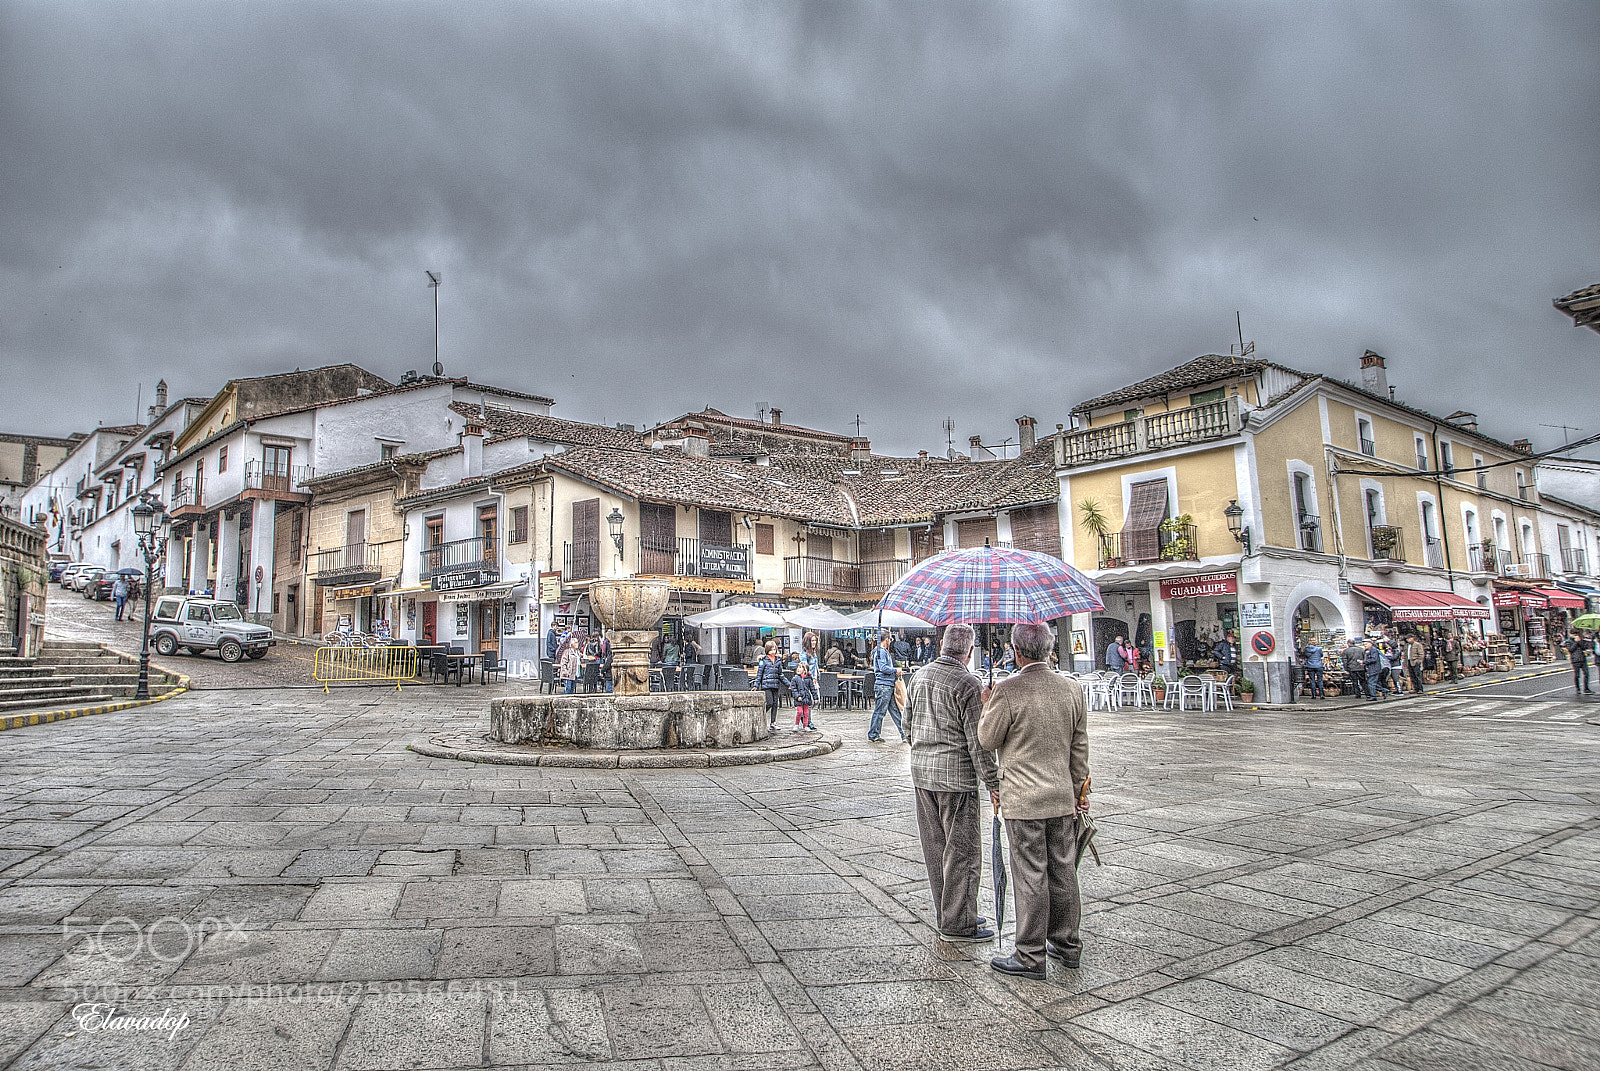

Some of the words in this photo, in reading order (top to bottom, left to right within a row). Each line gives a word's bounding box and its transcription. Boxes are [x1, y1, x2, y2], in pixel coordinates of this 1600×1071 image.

[1161, 577, 1195, 586] ARTESANIA
[1200, 573, 1236, 582] RECUERDOS
[1170, 583, 1228, 596] GUADALUPE
